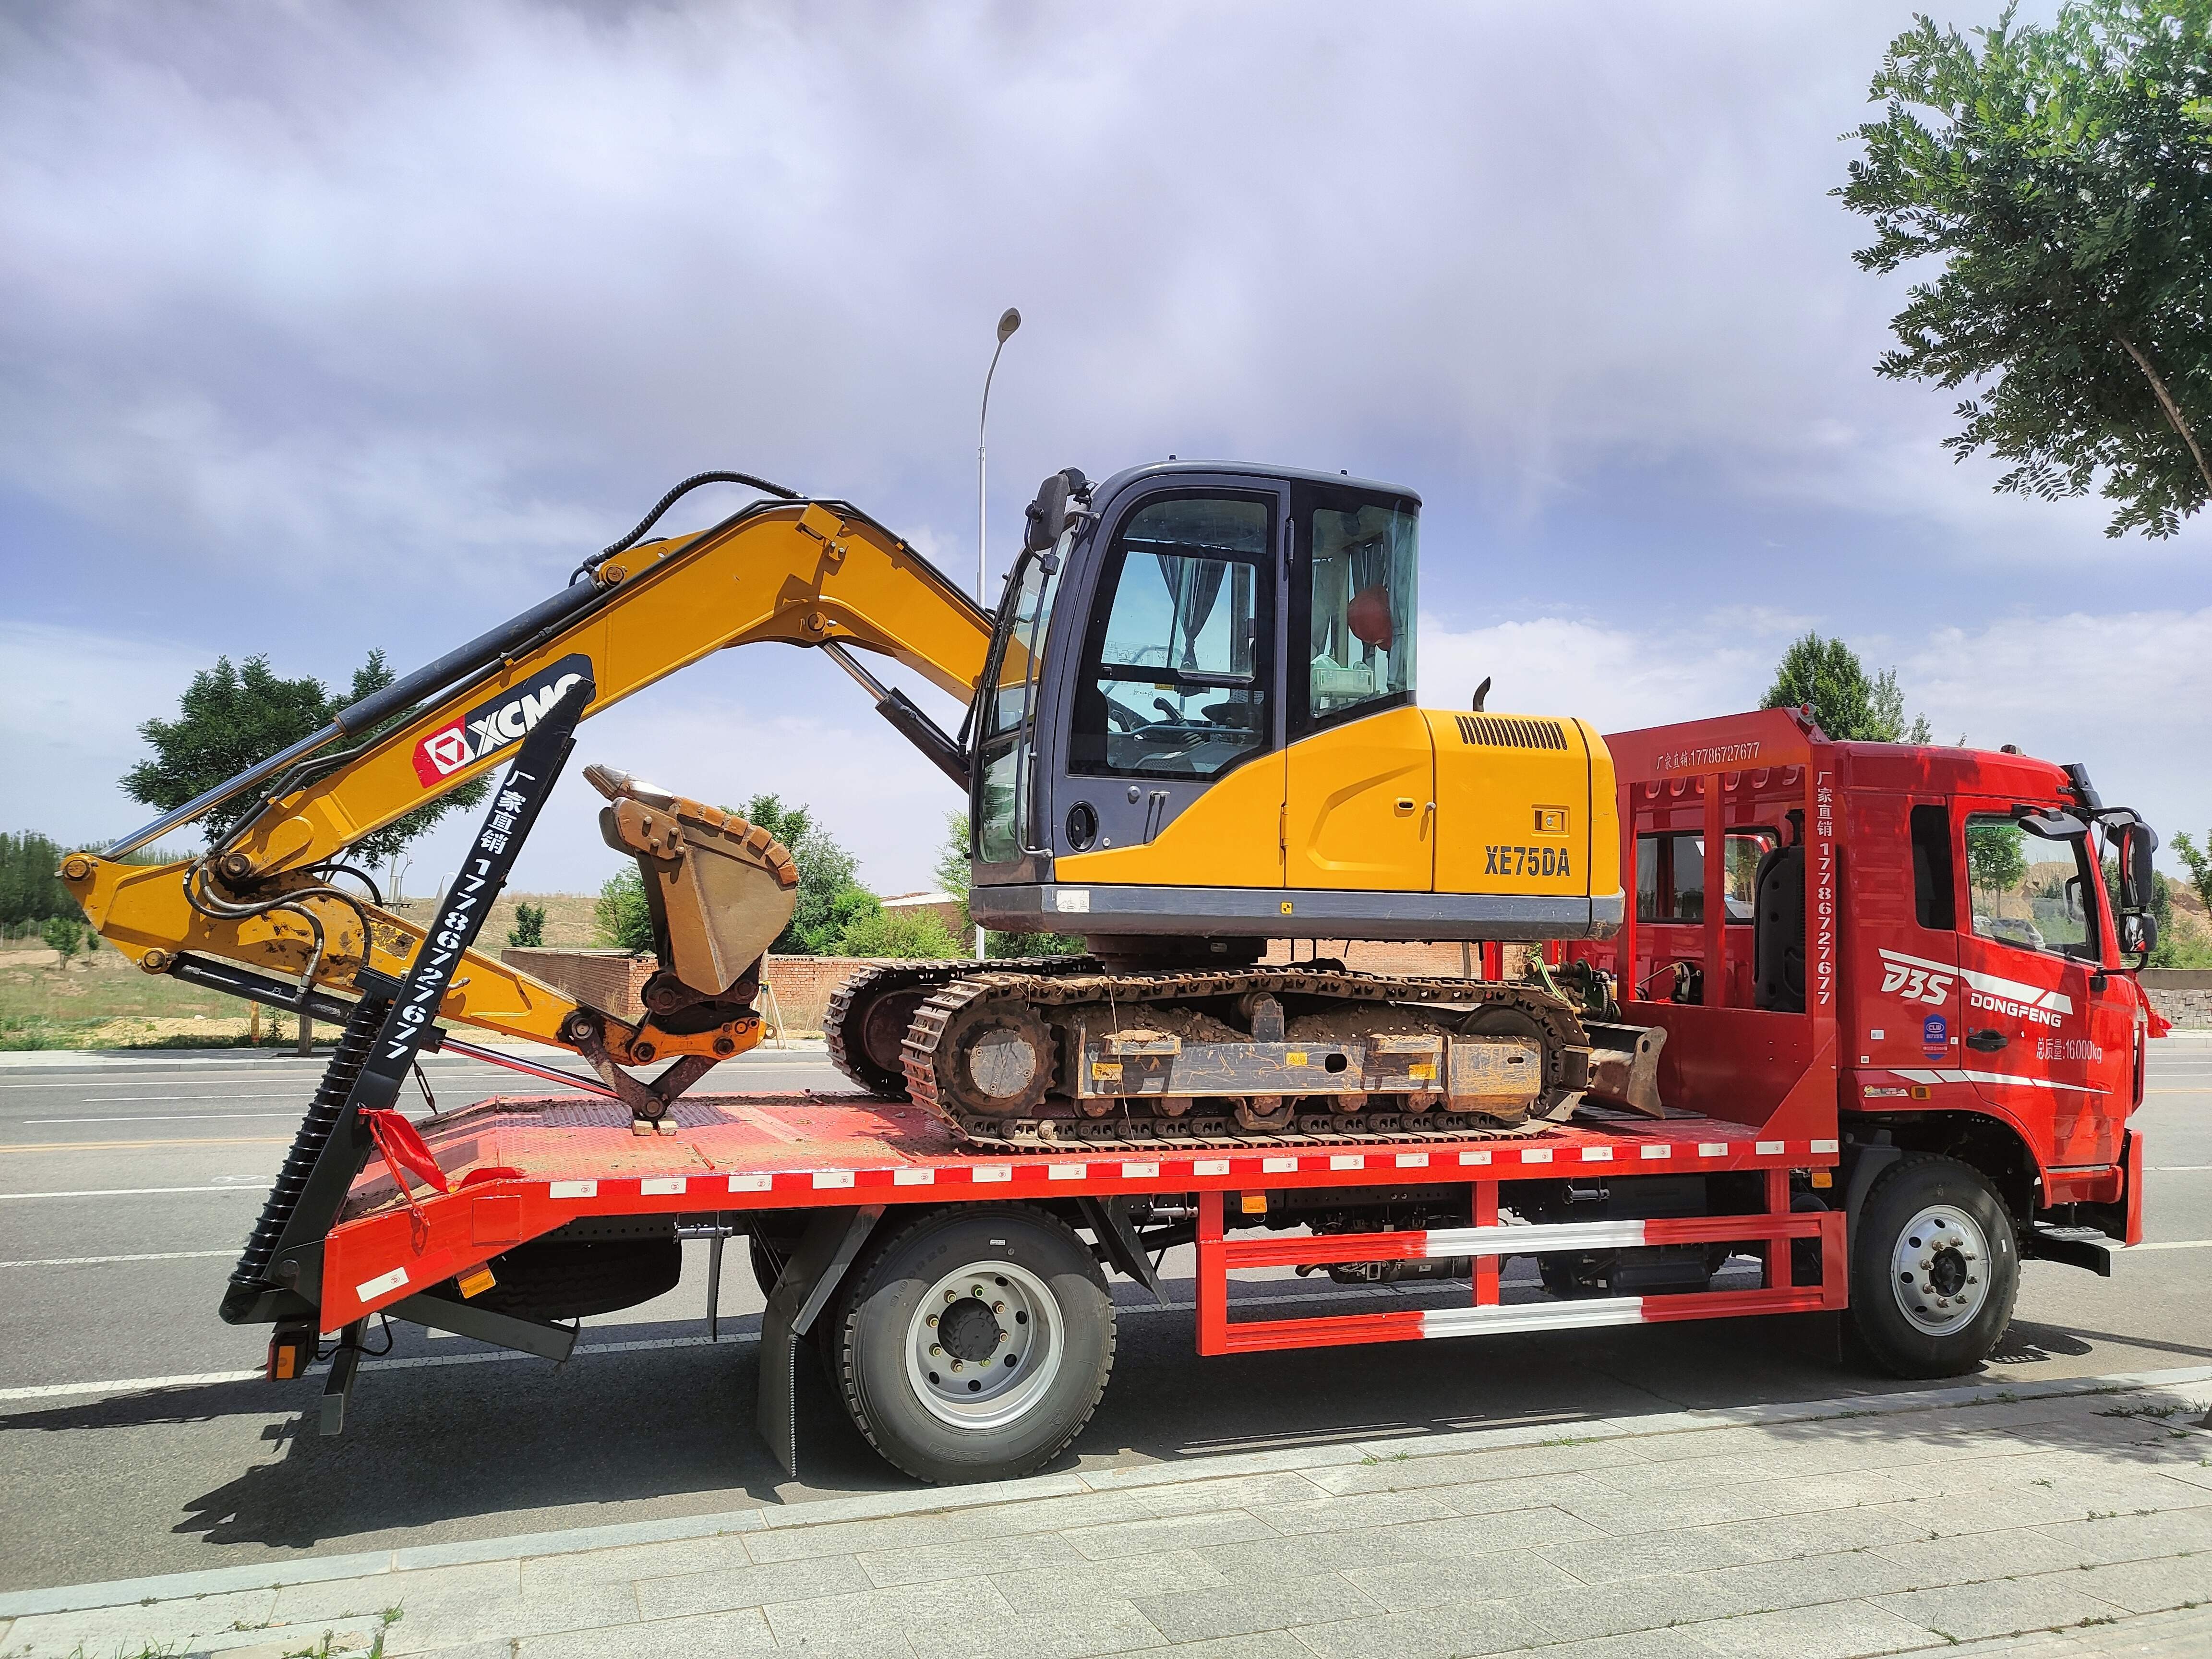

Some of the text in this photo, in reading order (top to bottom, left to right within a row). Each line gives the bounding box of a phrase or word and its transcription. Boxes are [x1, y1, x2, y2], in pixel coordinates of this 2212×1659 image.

[1484, 845, 1571, 877] XE75DA
[1815, 770, 1834, 1005] 厂家直销 17786727677
[385, 769, 536, 1059] 厂家直销 17786727677
[1880, 962, 1954, 1006] D3S
[1970, 992, 2062, 1028] DONGFENG
